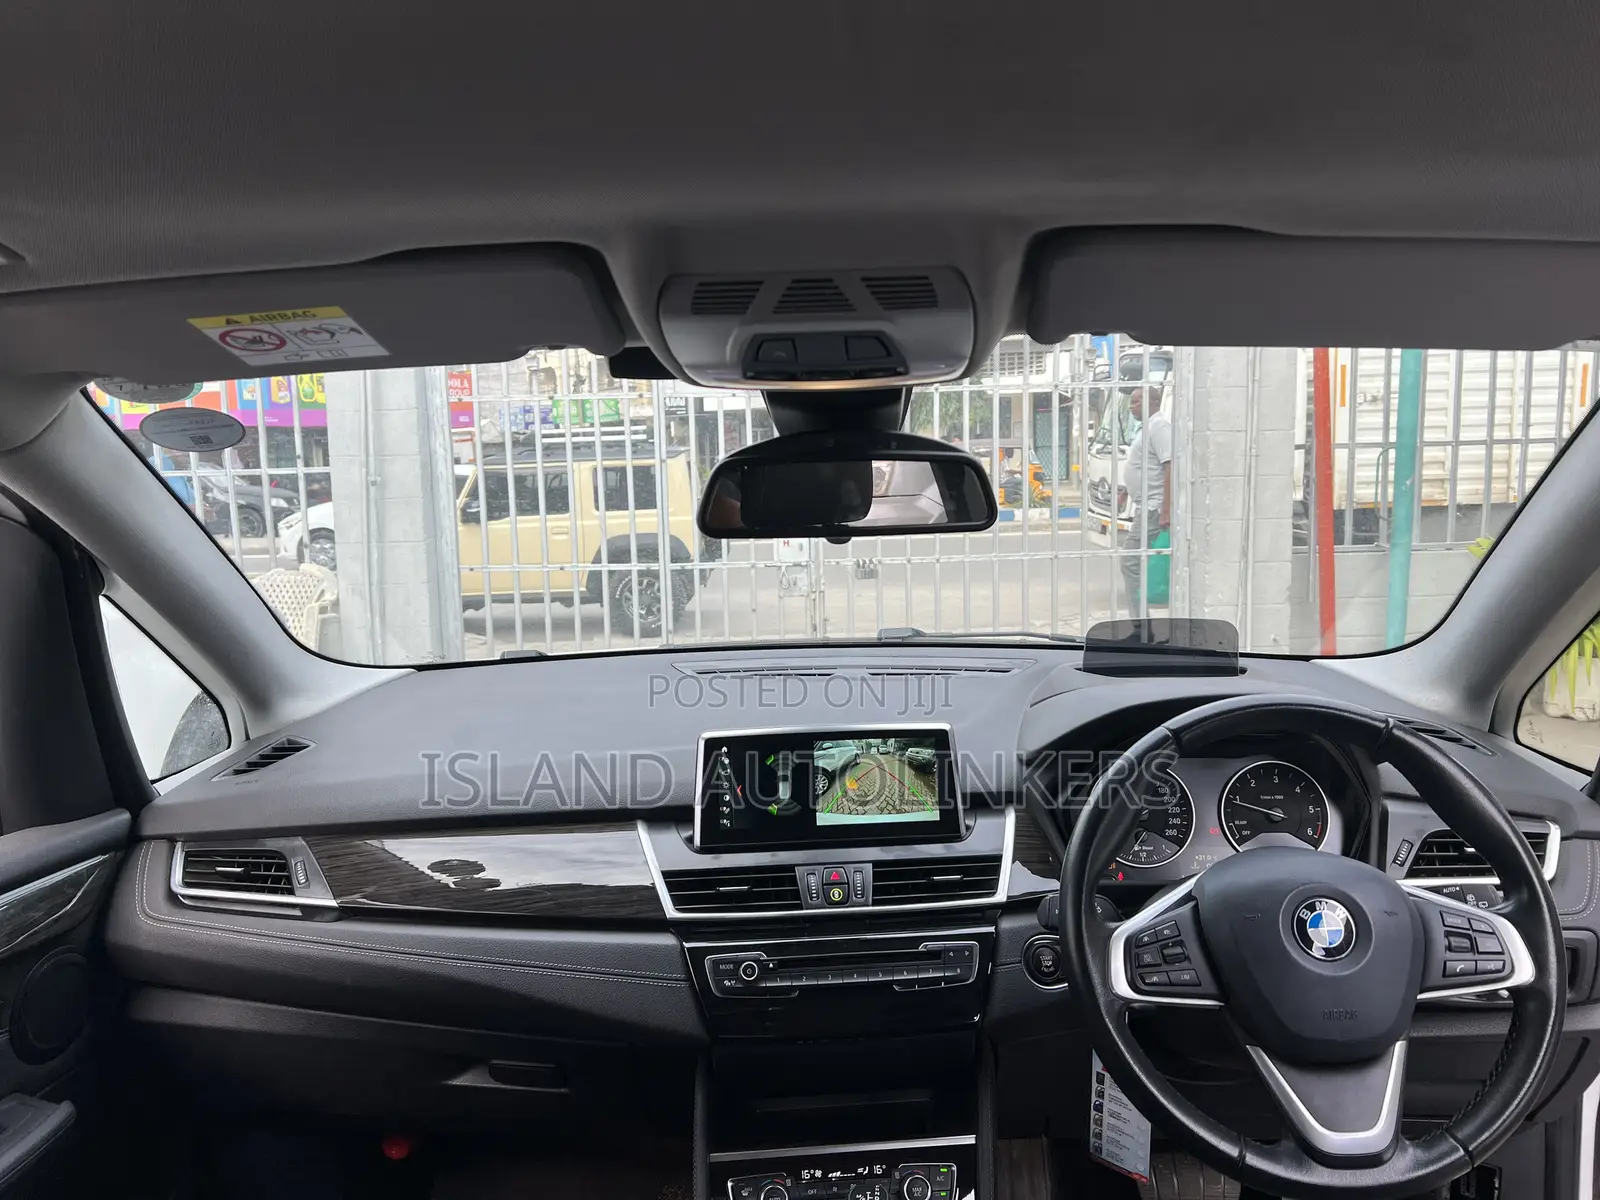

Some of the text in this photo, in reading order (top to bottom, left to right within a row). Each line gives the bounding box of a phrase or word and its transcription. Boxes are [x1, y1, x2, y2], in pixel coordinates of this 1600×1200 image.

[249, 310, 317, 324] AIRBAG
[1250, 779, 1256, 787] 2
[1273, 775, 1279, 783] 3
[1308, 805, 1315, 813] 5
[1307, 827, 1313, 835] 6
[1299, 901, 1347, 920] BMW
